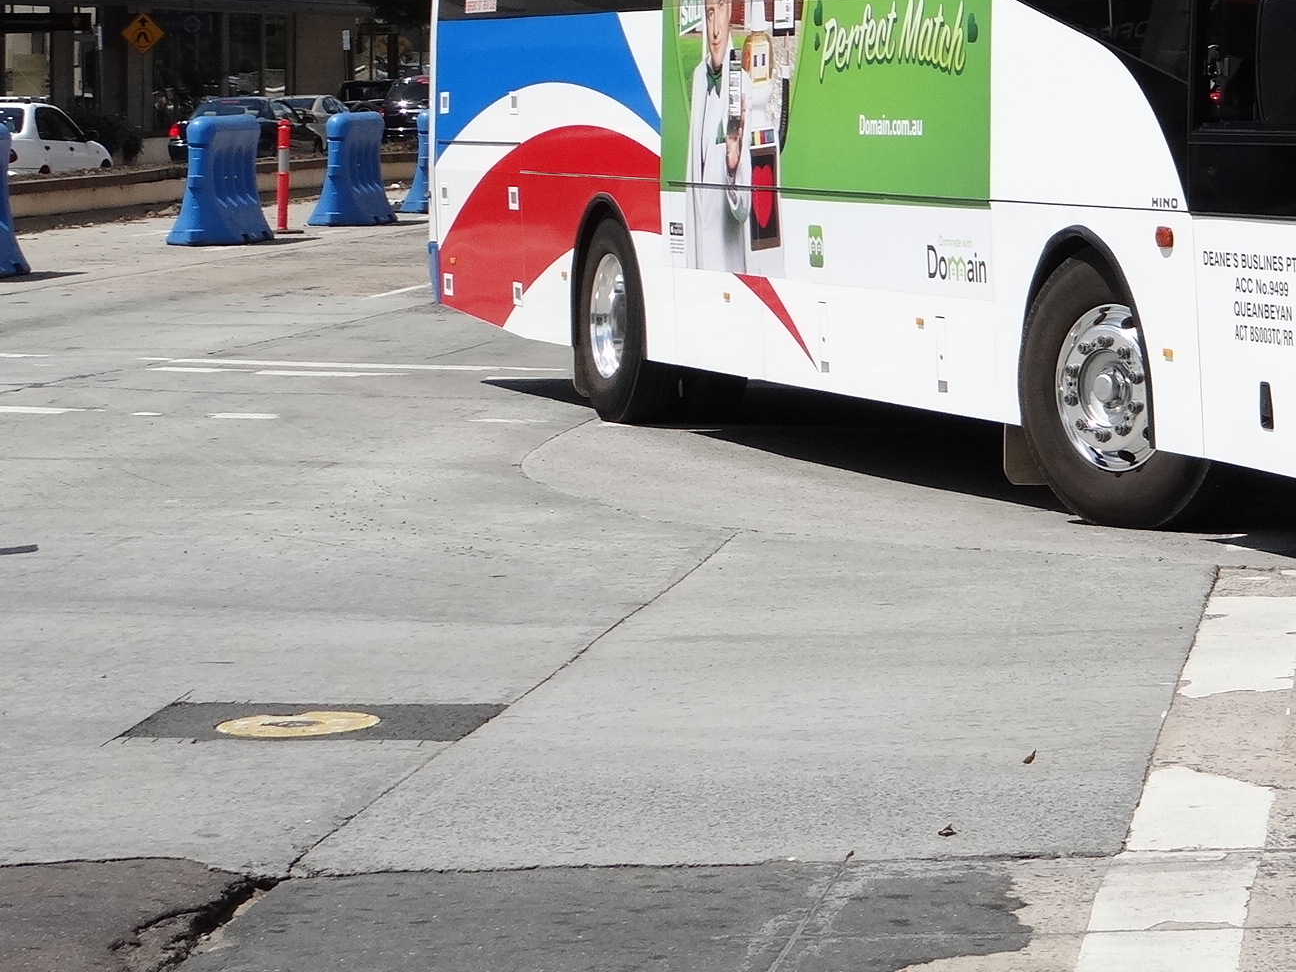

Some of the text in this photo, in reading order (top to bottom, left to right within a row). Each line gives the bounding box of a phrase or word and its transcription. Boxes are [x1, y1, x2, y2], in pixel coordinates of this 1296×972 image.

[818, 0, 898, 83] Perfect
[858, 114, 923, 136] Domain.com.au
[1151, 197, 1179, 209] HINO
[926, 244, 987, 284] Domain
[1202, 250, 1239, 269] DEANE'S
[1241, 253, 1284, 272] BUSLINES
[1235, 277, 1253, 294] ACC
[1233, 300, 1293, 322] QUEANBEYAN
[1235, 324, 1248, 342] ACT
